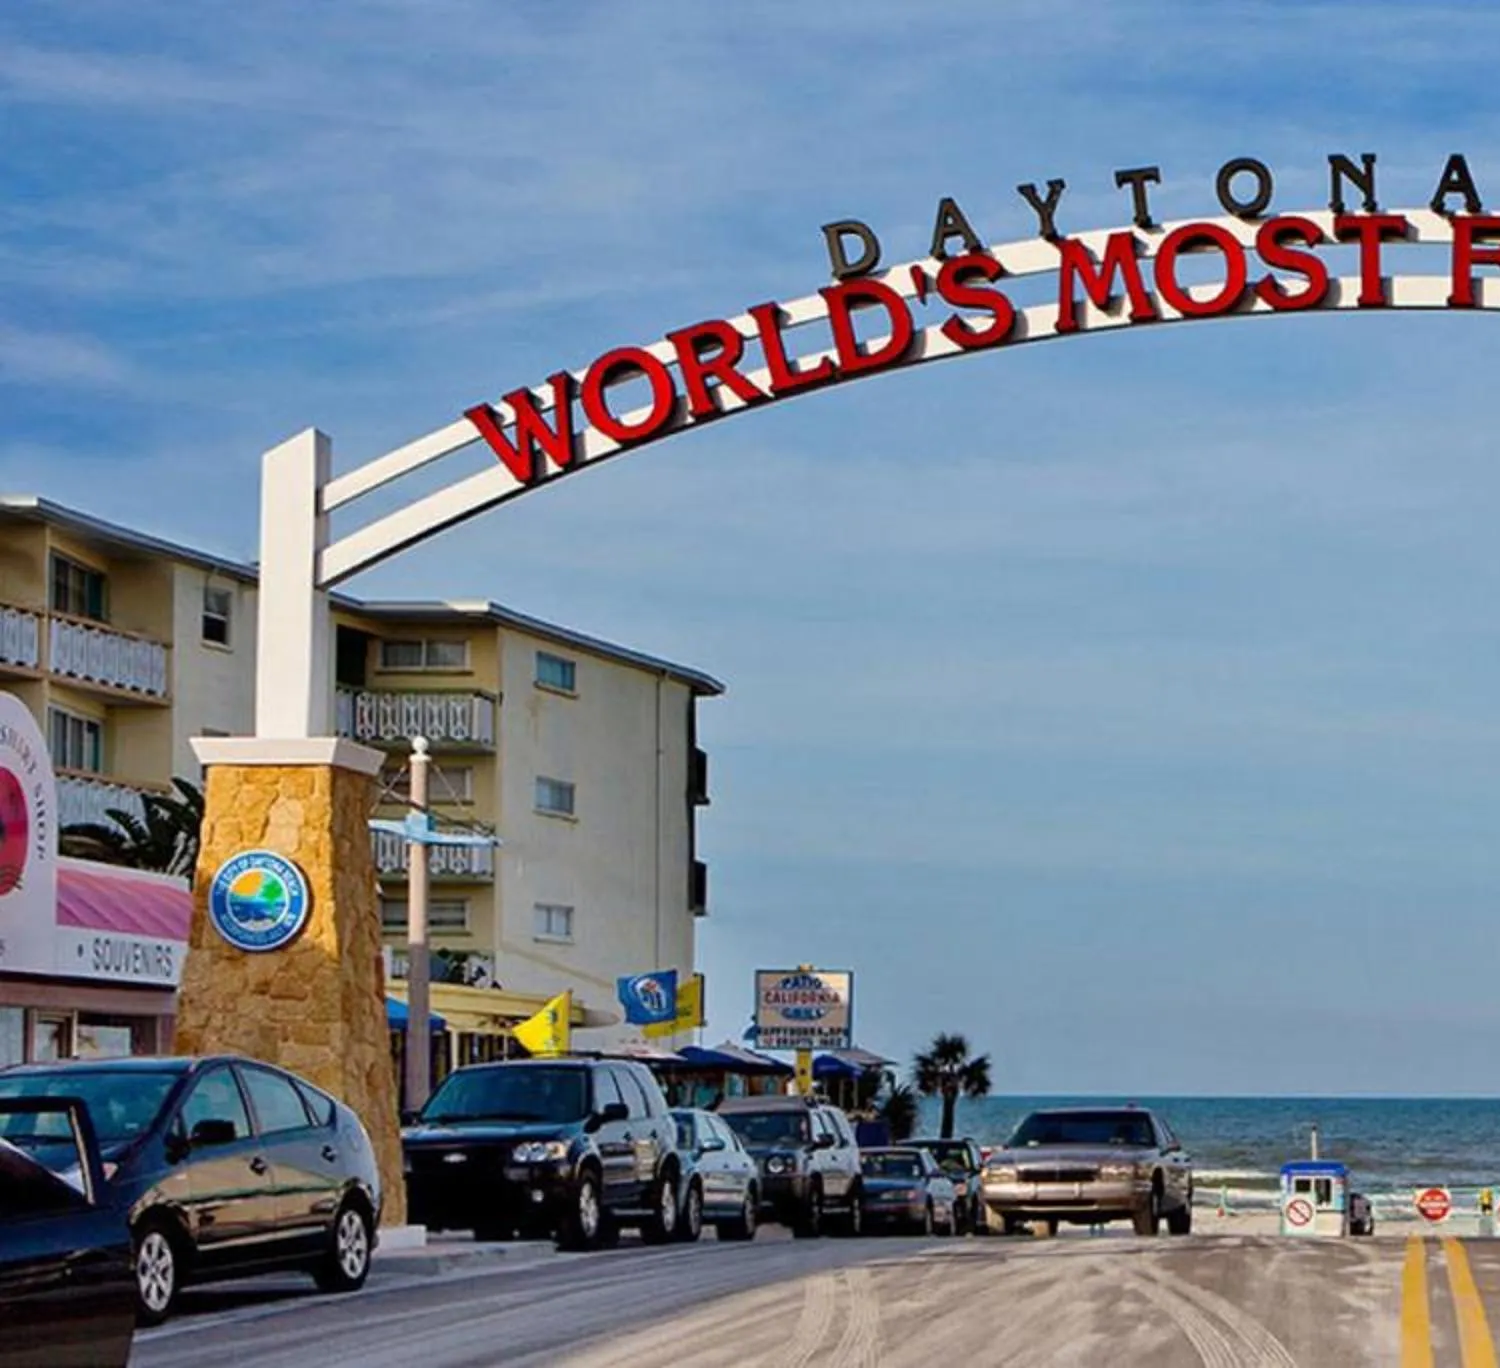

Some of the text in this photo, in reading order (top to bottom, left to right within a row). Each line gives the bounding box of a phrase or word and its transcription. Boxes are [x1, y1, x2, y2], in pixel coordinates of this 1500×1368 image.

[821, 153, 1483, 279] DAYTONA
[464, 251, 1018, 485] WORLD'S
[1054, 214, 1408, 332] MOST
[92, 938, 173, 977] SOUVENIRS
[764, 991, 841, 1004] CALIFORNIA
